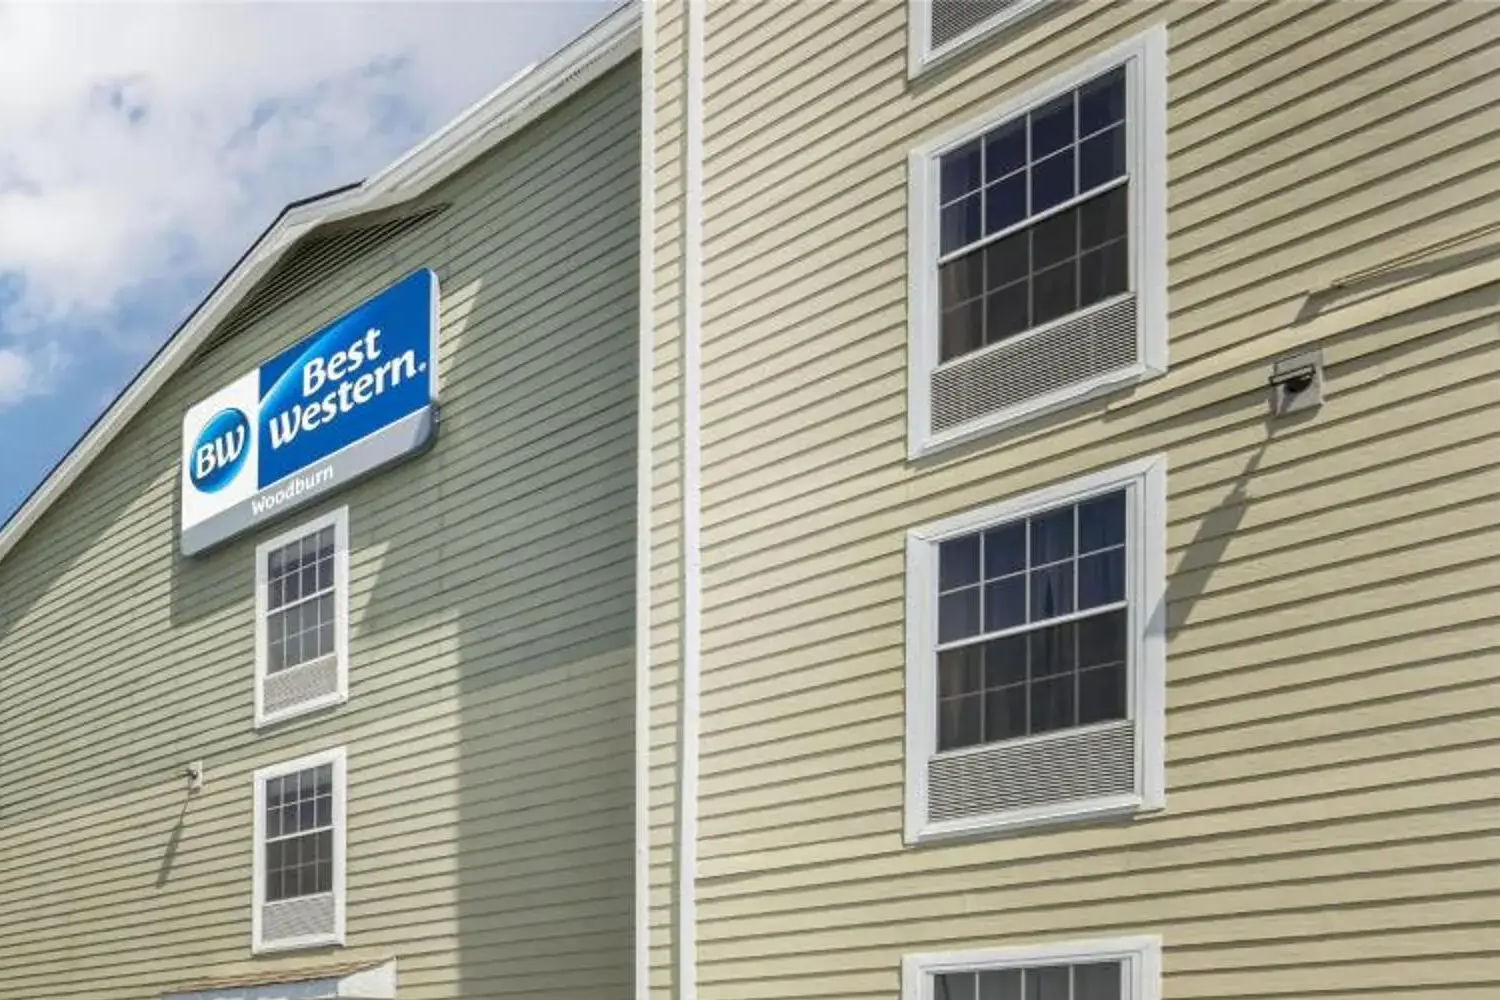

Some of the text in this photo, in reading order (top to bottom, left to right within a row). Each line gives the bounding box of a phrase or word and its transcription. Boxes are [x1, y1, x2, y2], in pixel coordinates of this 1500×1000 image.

[303, 328, 381, 397] Best
[196, 424, 245, 479] BW
[251, 463, 334, 516] Woodburn
